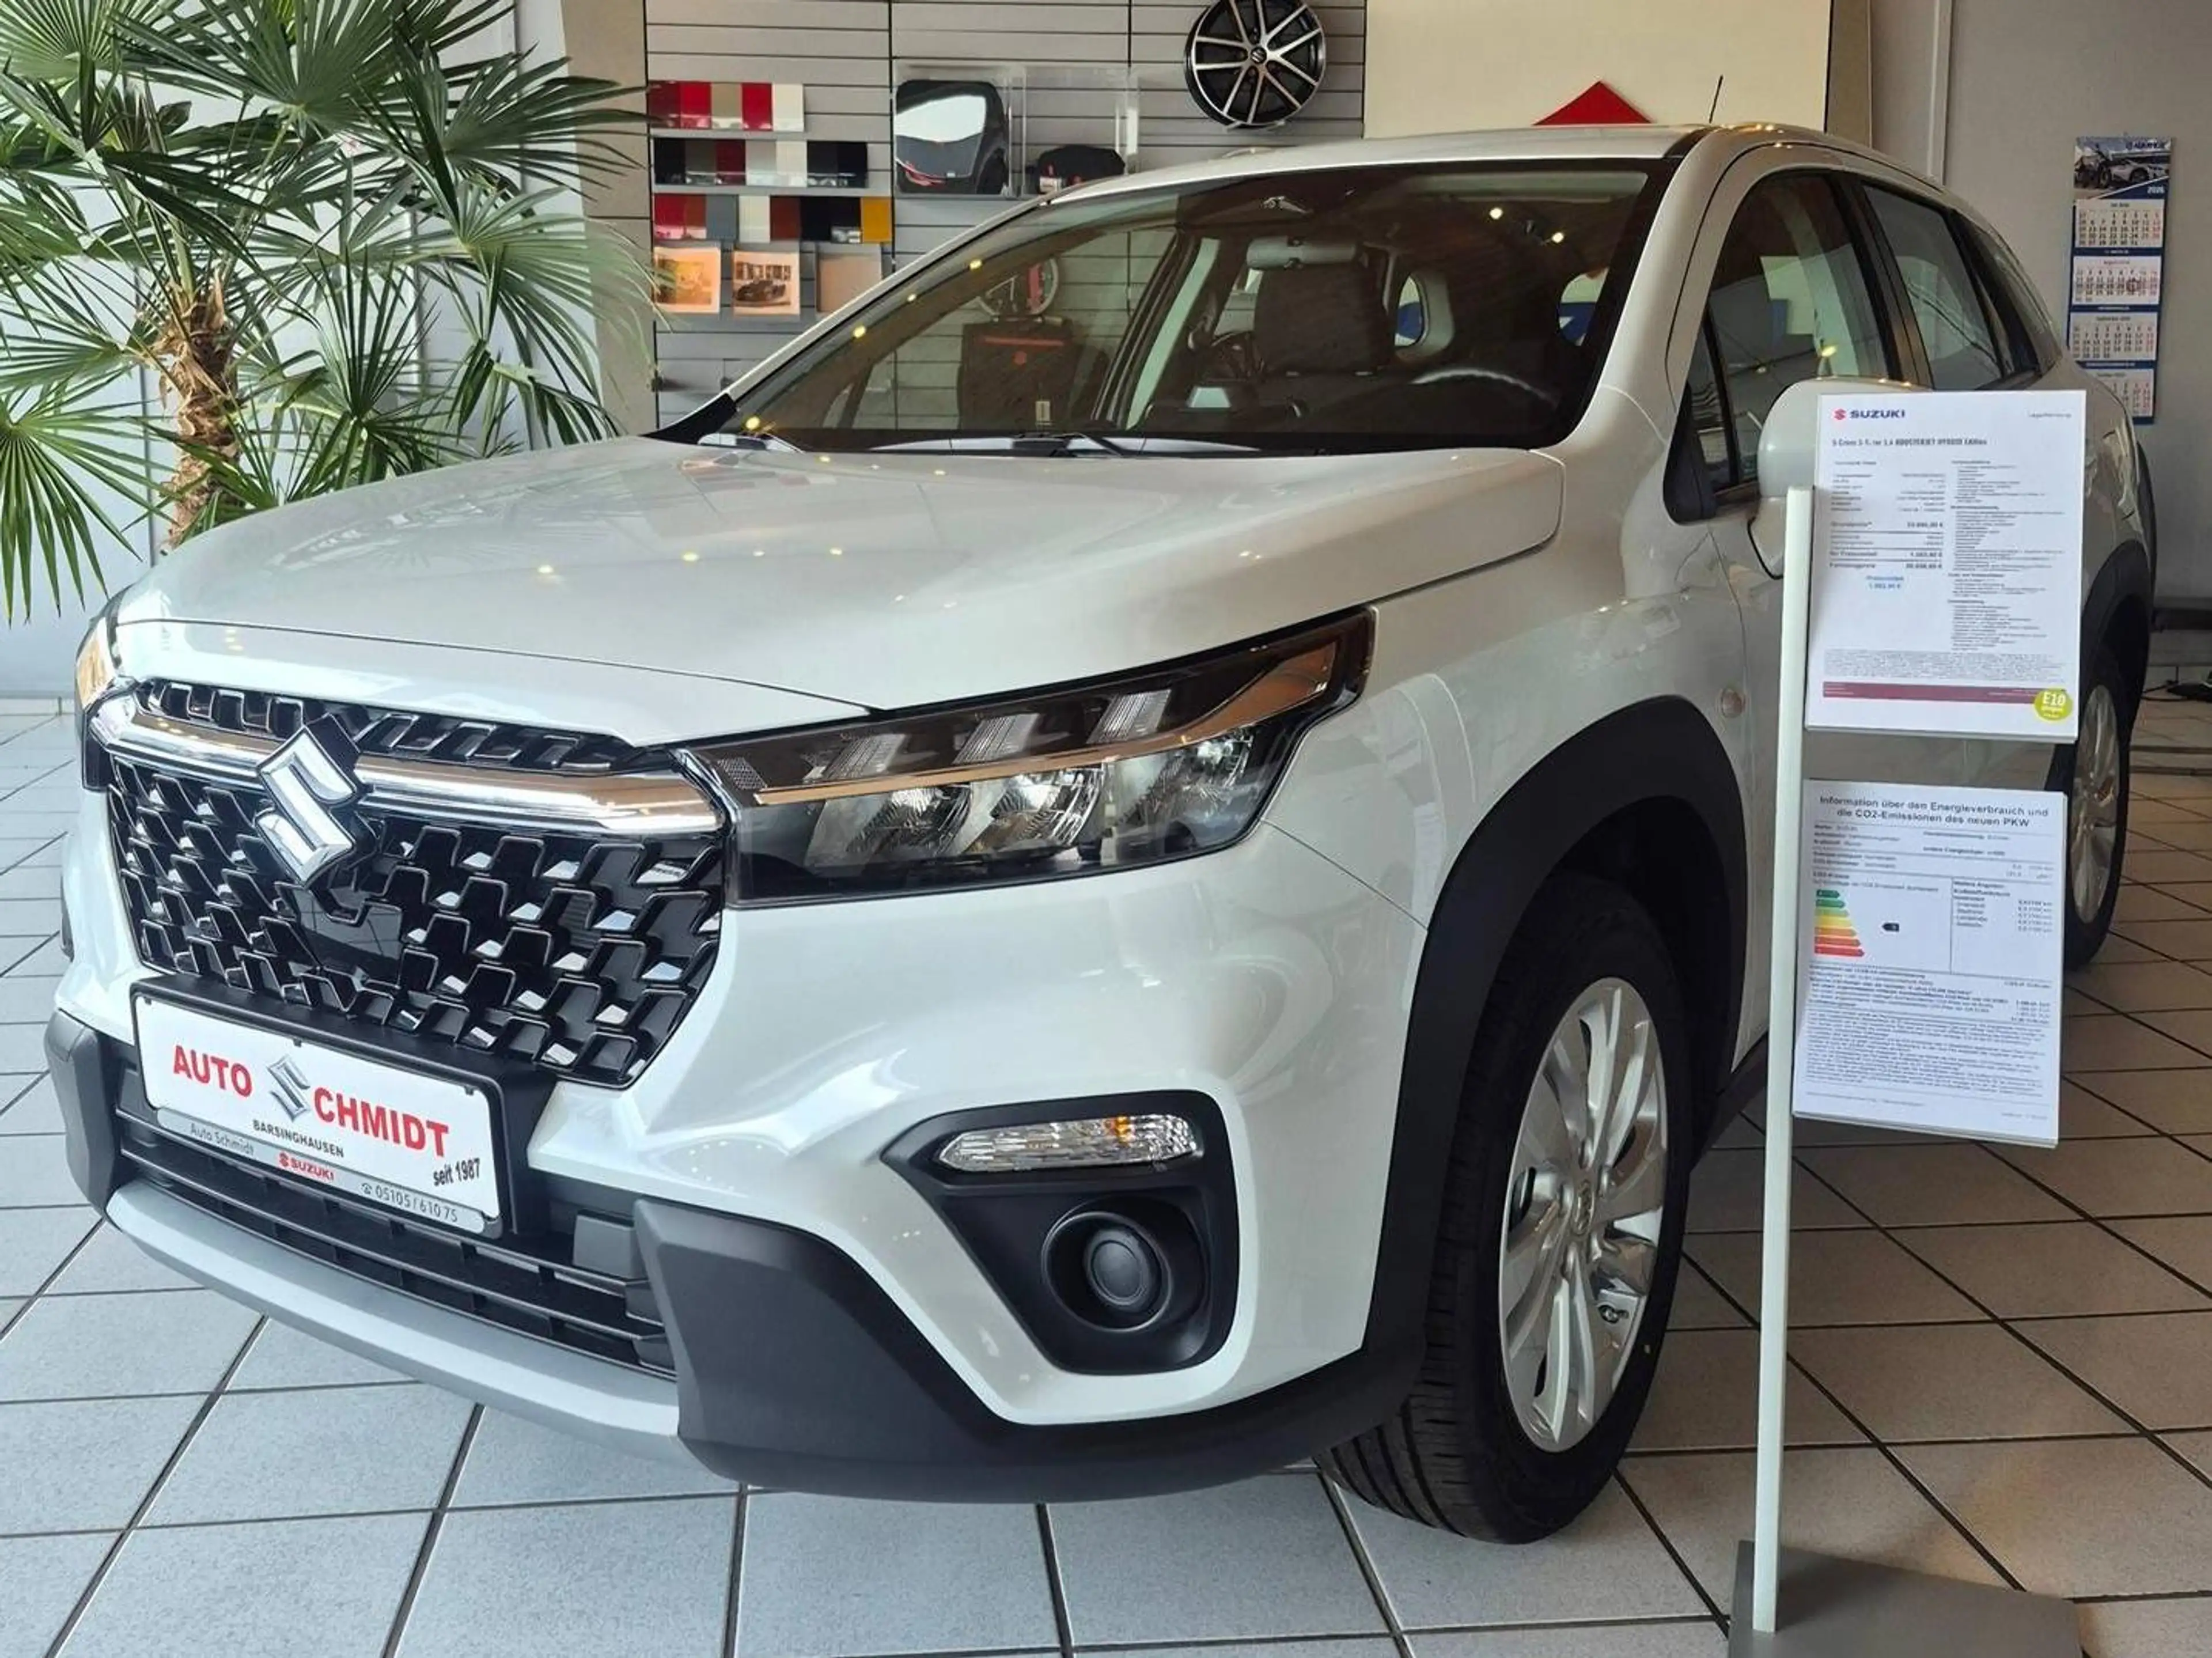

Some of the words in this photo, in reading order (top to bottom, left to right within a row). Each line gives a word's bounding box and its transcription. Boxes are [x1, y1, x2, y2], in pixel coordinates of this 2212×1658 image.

[1850, 410, 1906, 418] SUZUKI
[2043, 691, 2066, 706] E10
[1820, 796, 1878, 807] Information
[1881, 798, 1904, 808] über
[1908, 801, 1927, 809] den
[1930, 802, 2025, 816] Energieverbrauch
[2028, 808, 2048, 816] und
[1855, 809, 1942, 823] CO2-Emissionen
[1945, 815, 1964, 824] des
[1967, 817, 2000, 826] neuen
[2003, 817, 2030, 827] PKW
[173, 1044, 252, 1097] AUTO
[190, 1123, 213, 1141] Auto
[214, 1132, 254, 1156] Schmidt
[252, 1119, 344, 1157] BARSINGHAUSEN
[291, 1157, 335, 1180] SUZUKI
[433, 1166, 453, 1187] seit
[454, 1157, 480, 1182] 1987
